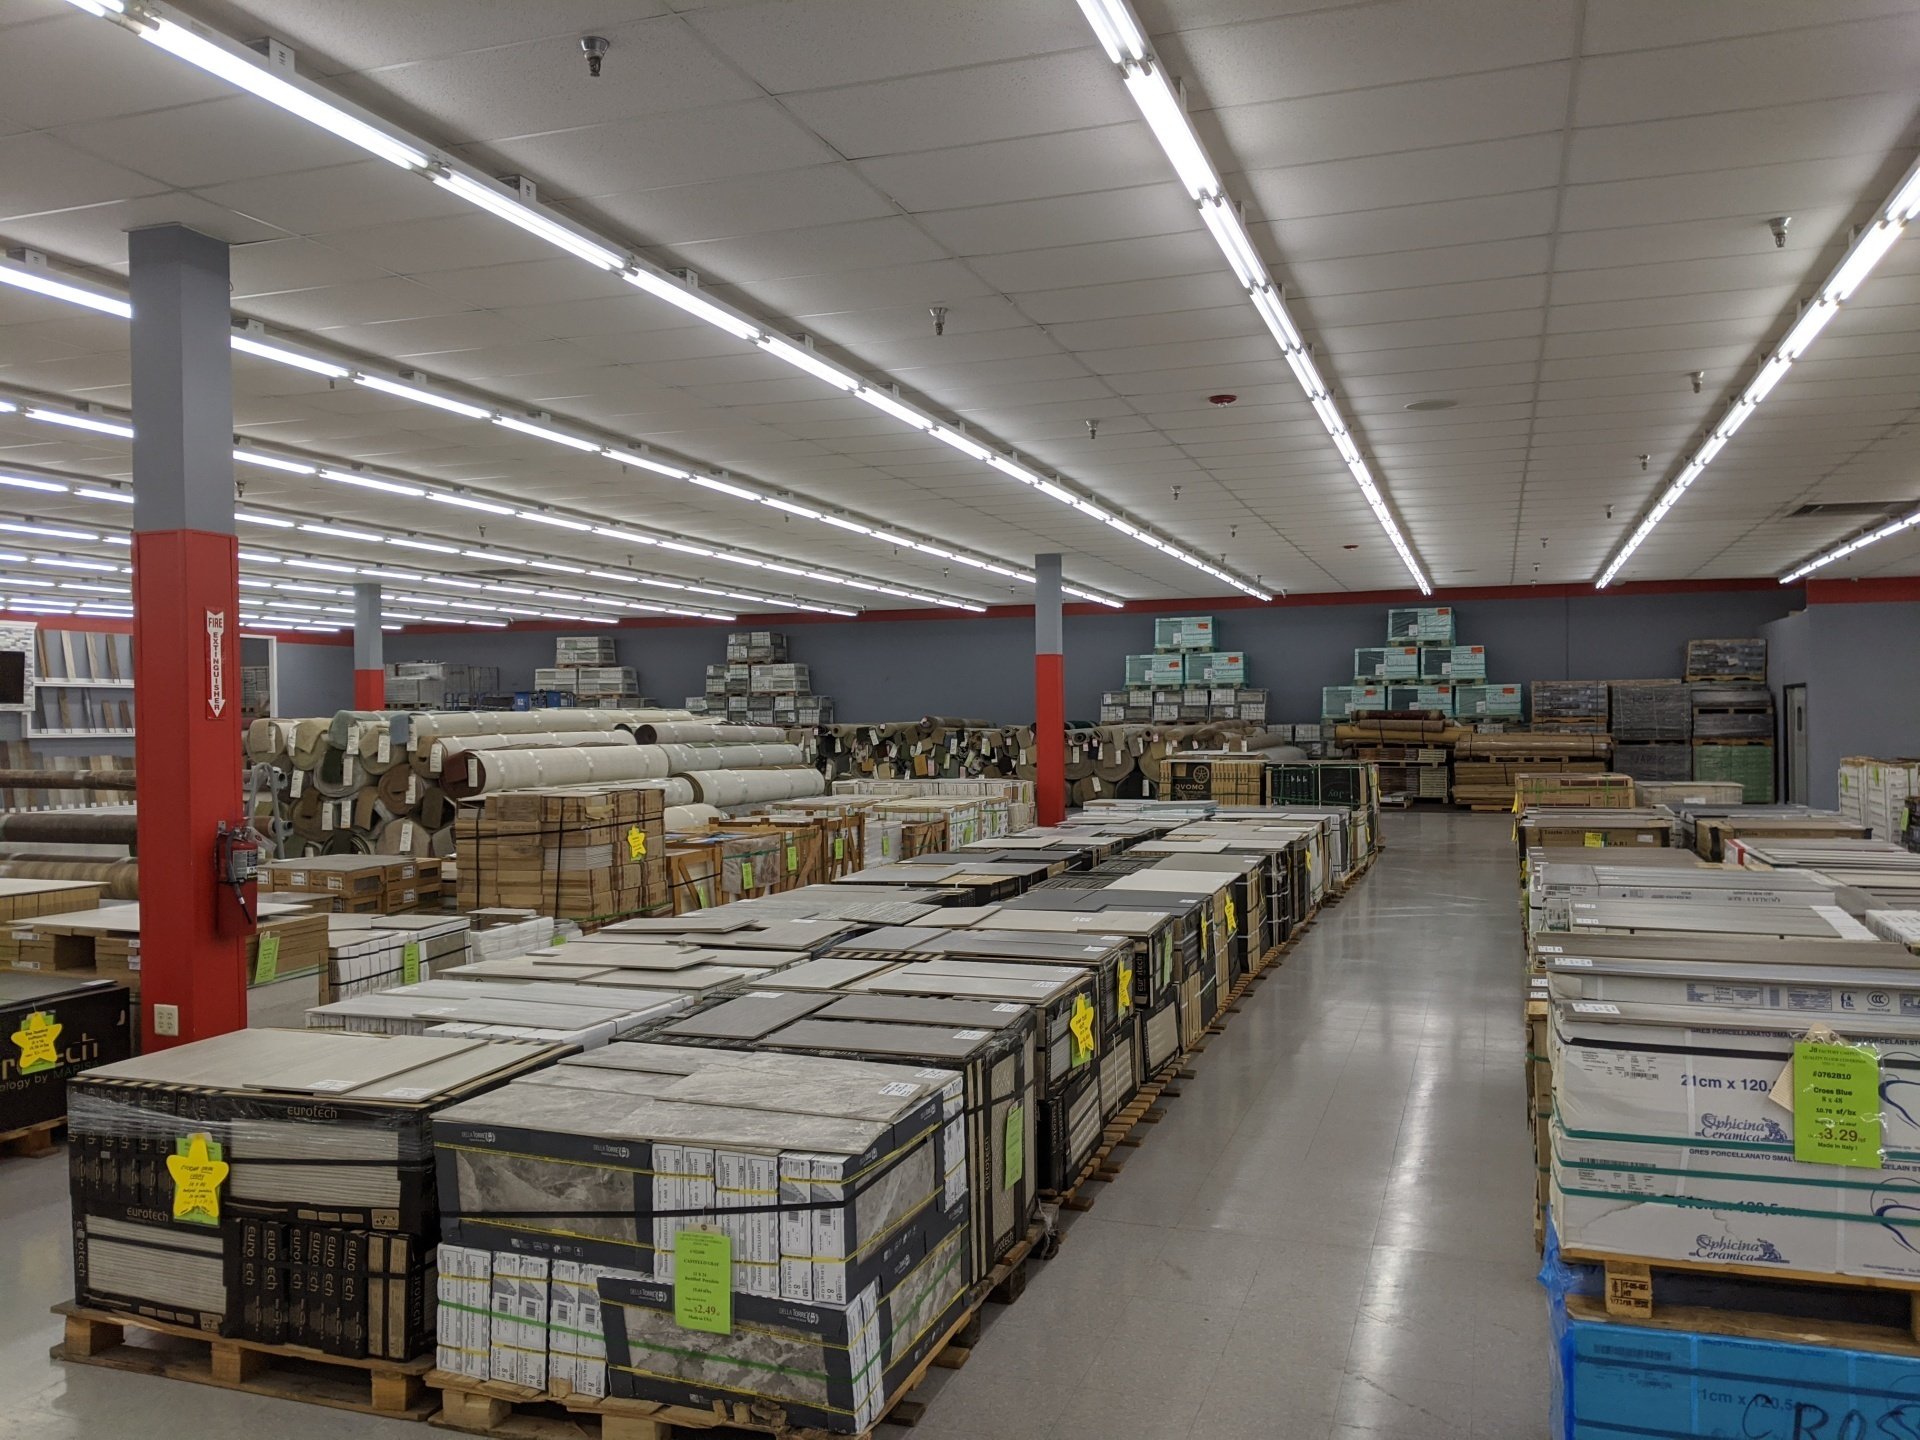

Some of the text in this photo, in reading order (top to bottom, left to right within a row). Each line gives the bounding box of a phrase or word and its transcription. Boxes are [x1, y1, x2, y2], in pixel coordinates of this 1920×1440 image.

[208, 617, 223, 629] FIRE
[212, 631, 221, 711] EXTINGUISHER
[34, 1074, 48, 1084] by
[1681, 1074, 1722, 1089] 21cm
[1727, 1079, 1736, 1090] x
[1835, 1088, 1853, 1096] Blue
[287, 1105, 338, 1120] eurotech
[1710, 1150, 1771, 1162] PORCELLANATO
[126, 1207, 169, 1222] eurotech
[246, 1225, 257, 1286] euroech
[266, 1229, 278, 1291] euroech
[1696, 1246, 1754, 1262] Ceramica
[324, 1235, 337, 1298] euroech
[344, 1239, 357, 1302] euroech
[793, 1309, 809, 1319] TORRE
